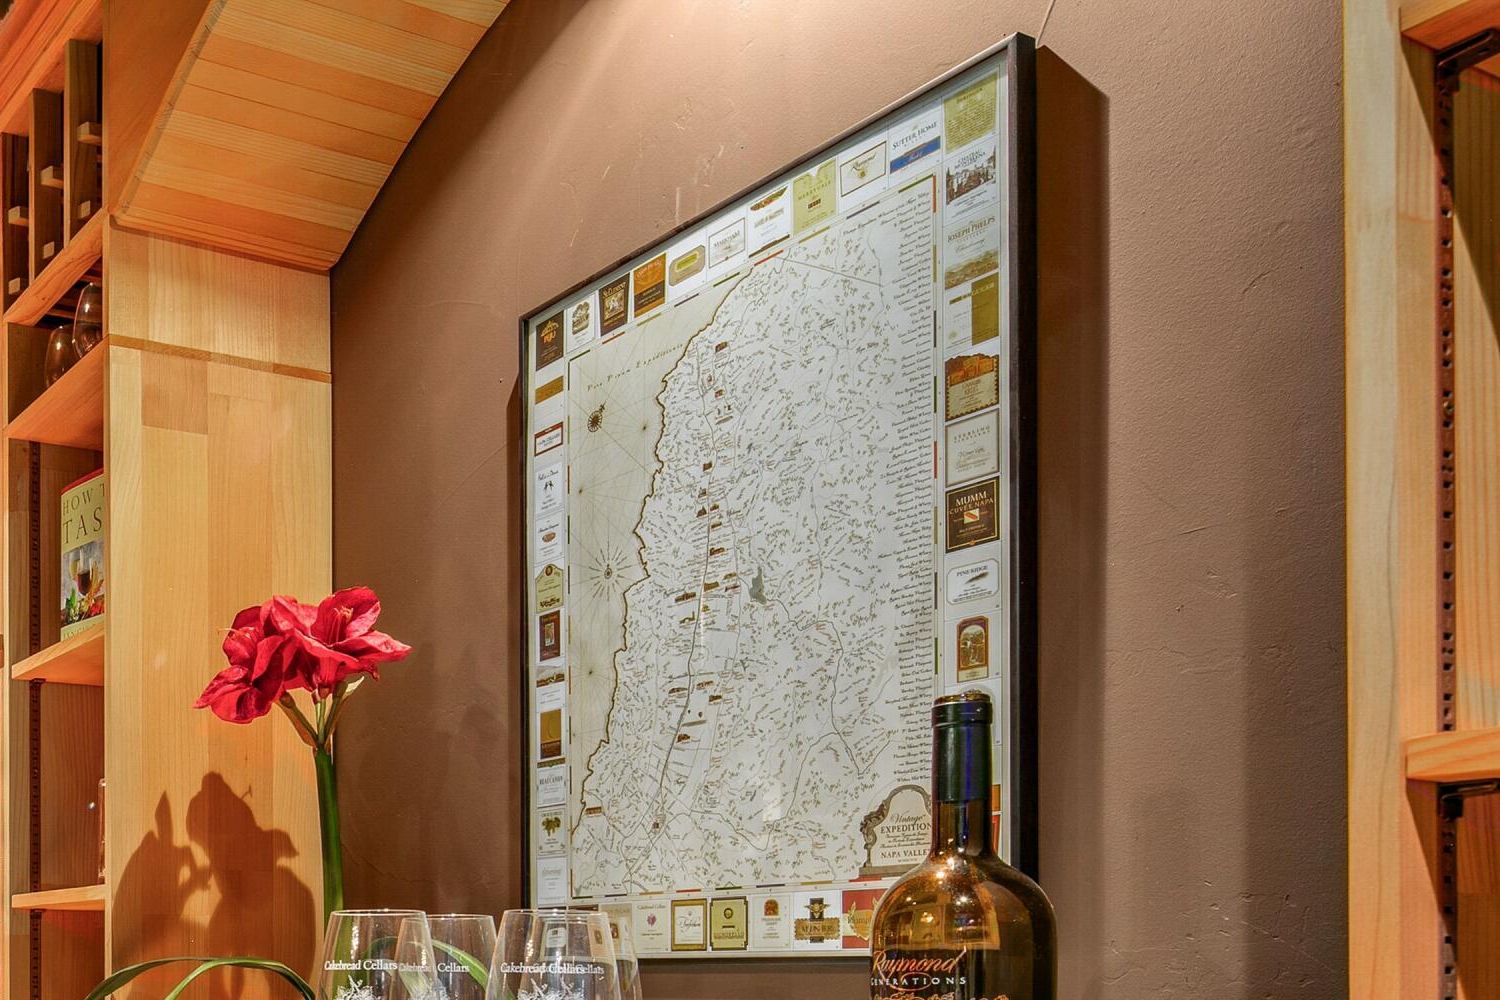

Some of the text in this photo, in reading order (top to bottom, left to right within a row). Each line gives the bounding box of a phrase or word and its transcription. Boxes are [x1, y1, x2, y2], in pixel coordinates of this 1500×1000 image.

[893, 121, 937, 150] SUTTER HOME
[947, 215, 996, 244] JOSEPH PHELPS
[62, 487, 94, 517] HOW
[955, 490, 988, 507] MUMM
[974, 497, 994, 508] NAPA
[956, 564, 989, 577] PINE RIDGE
[881, 848, 930, 859] NAPA VALLE
[324, 959, 399, 971] Cakebread Cellars
[437, 962, 470, 974] Cellars
[872, 945, 967, 982] Raymond
[870, 976, 968, 986] GENERATIONS
